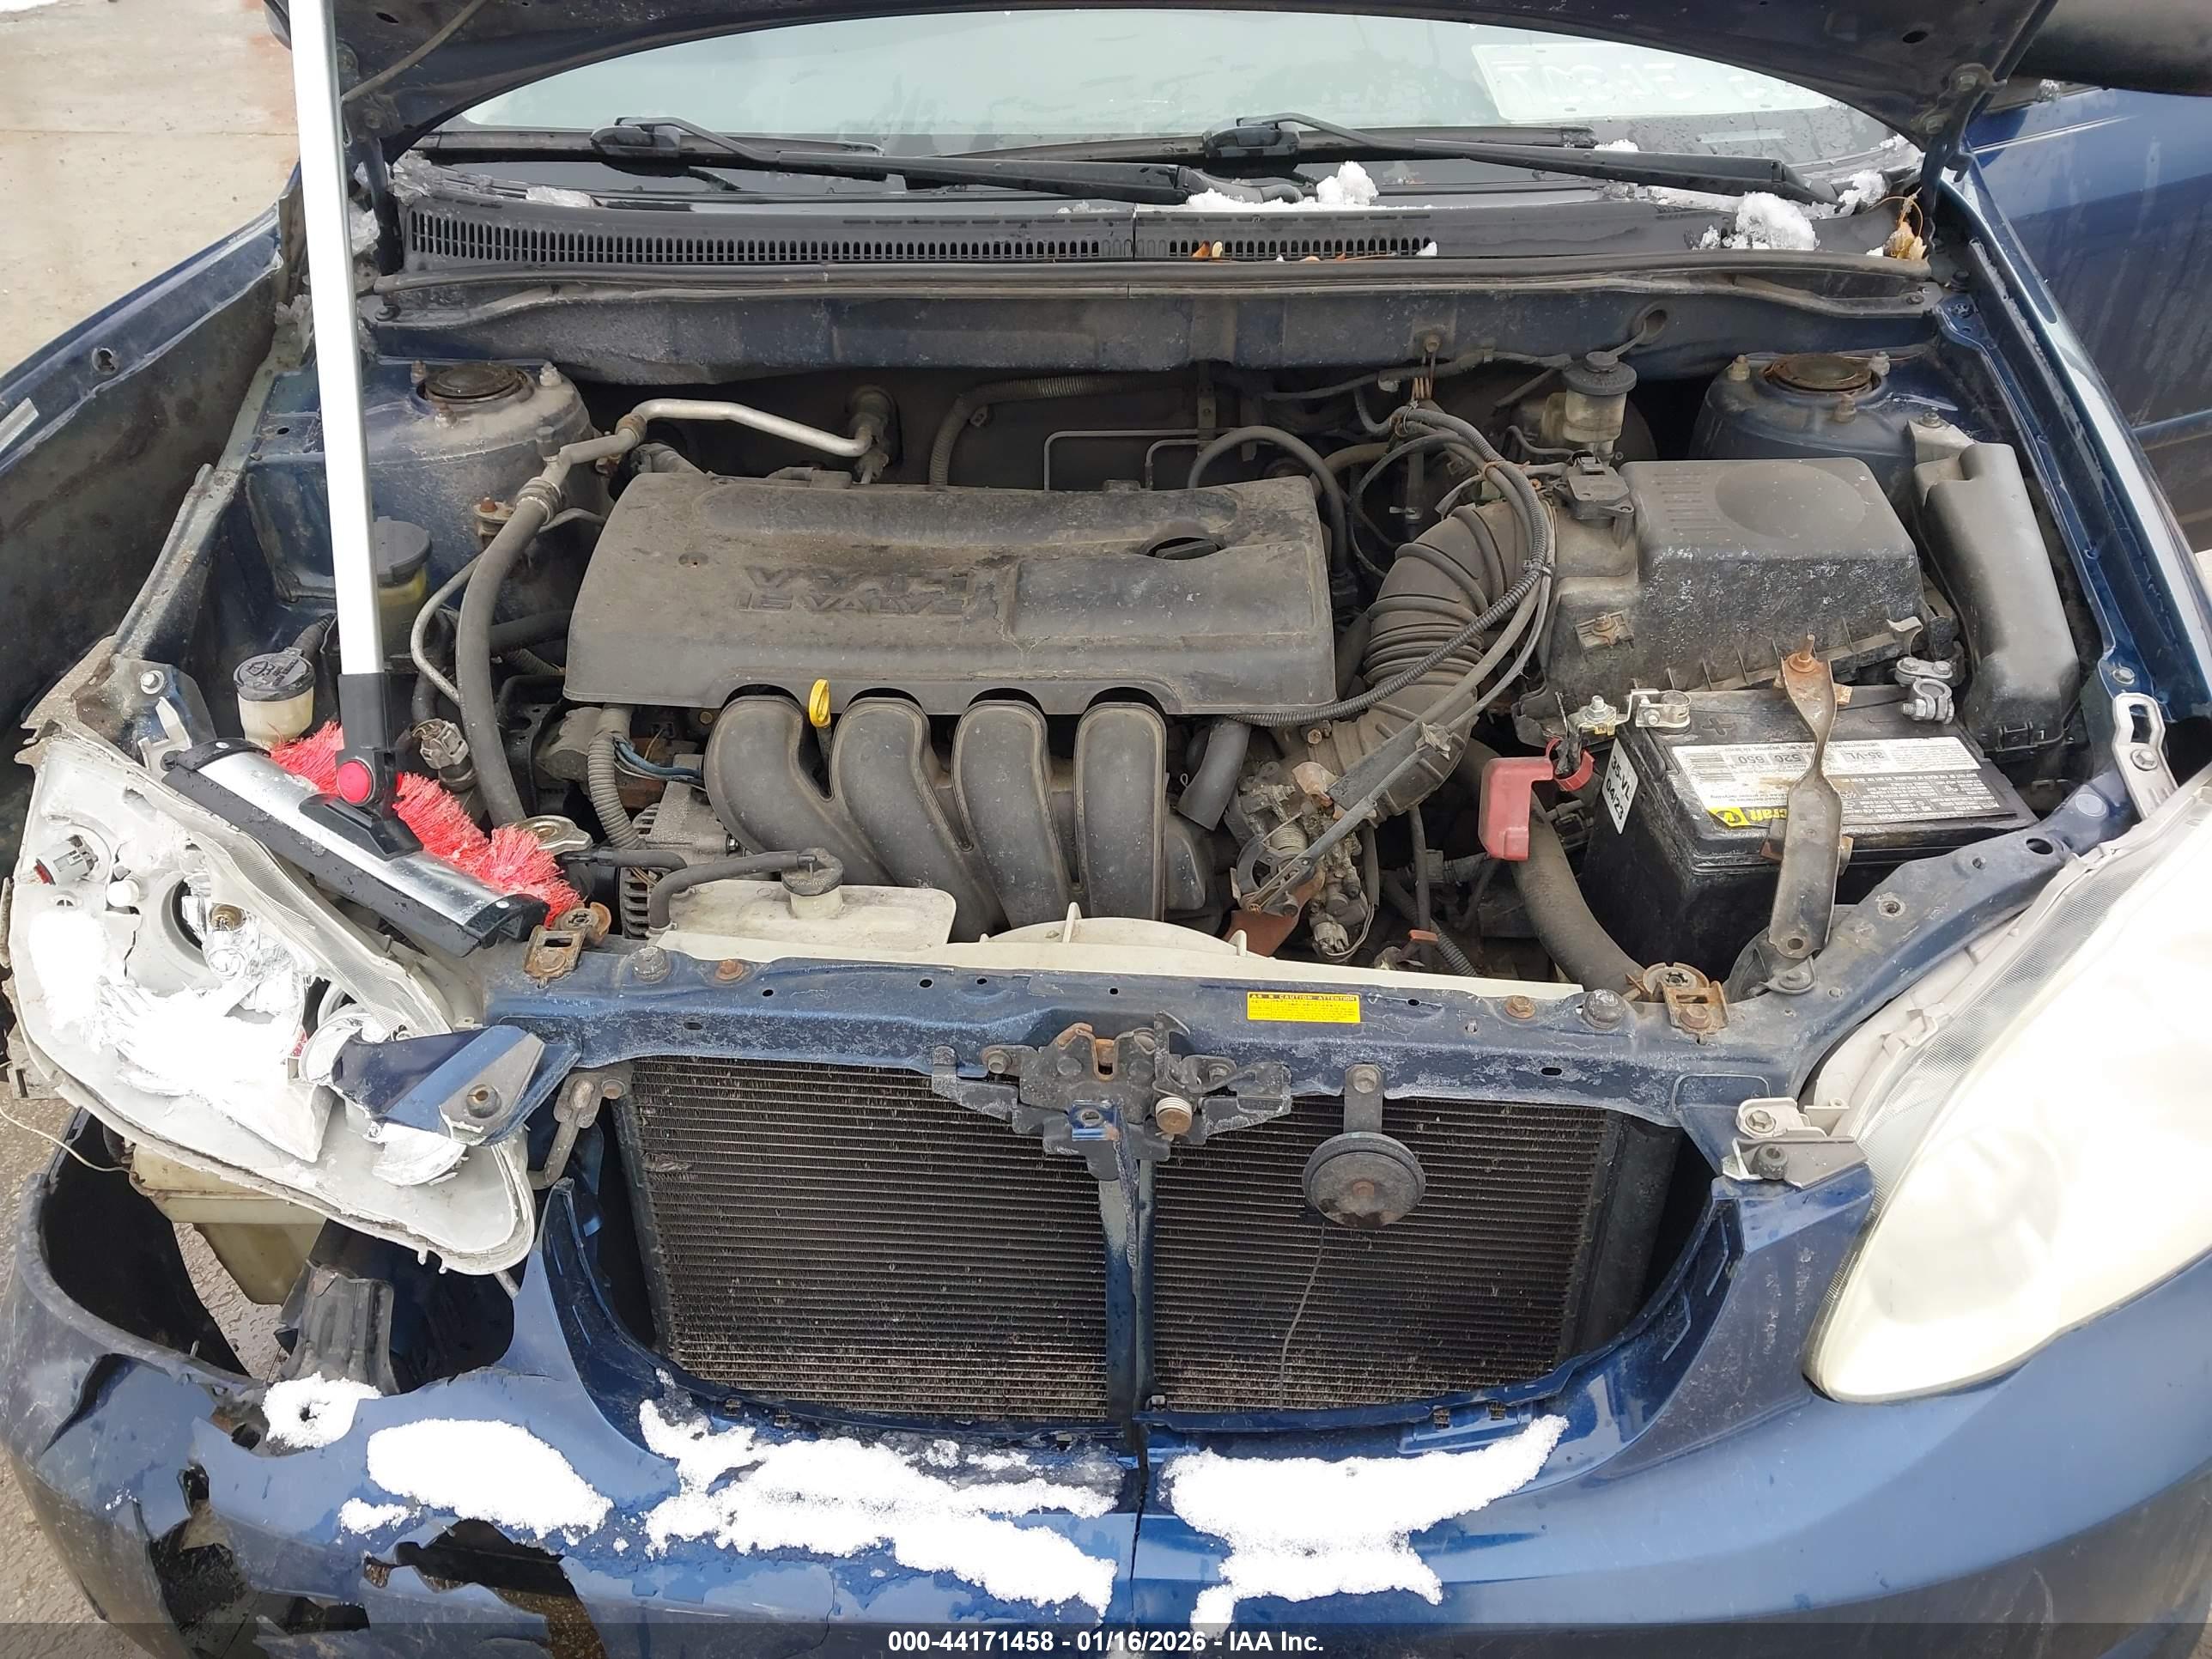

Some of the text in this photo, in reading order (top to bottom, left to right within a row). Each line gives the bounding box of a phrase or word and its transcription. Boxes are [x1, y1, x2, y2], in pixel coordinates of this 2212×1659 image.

[1844, 751, 1885, 760] 35-VL
[1606, 776, 1625, 821] 04/23
[1611, 755, 1631, 802] 35-VL
